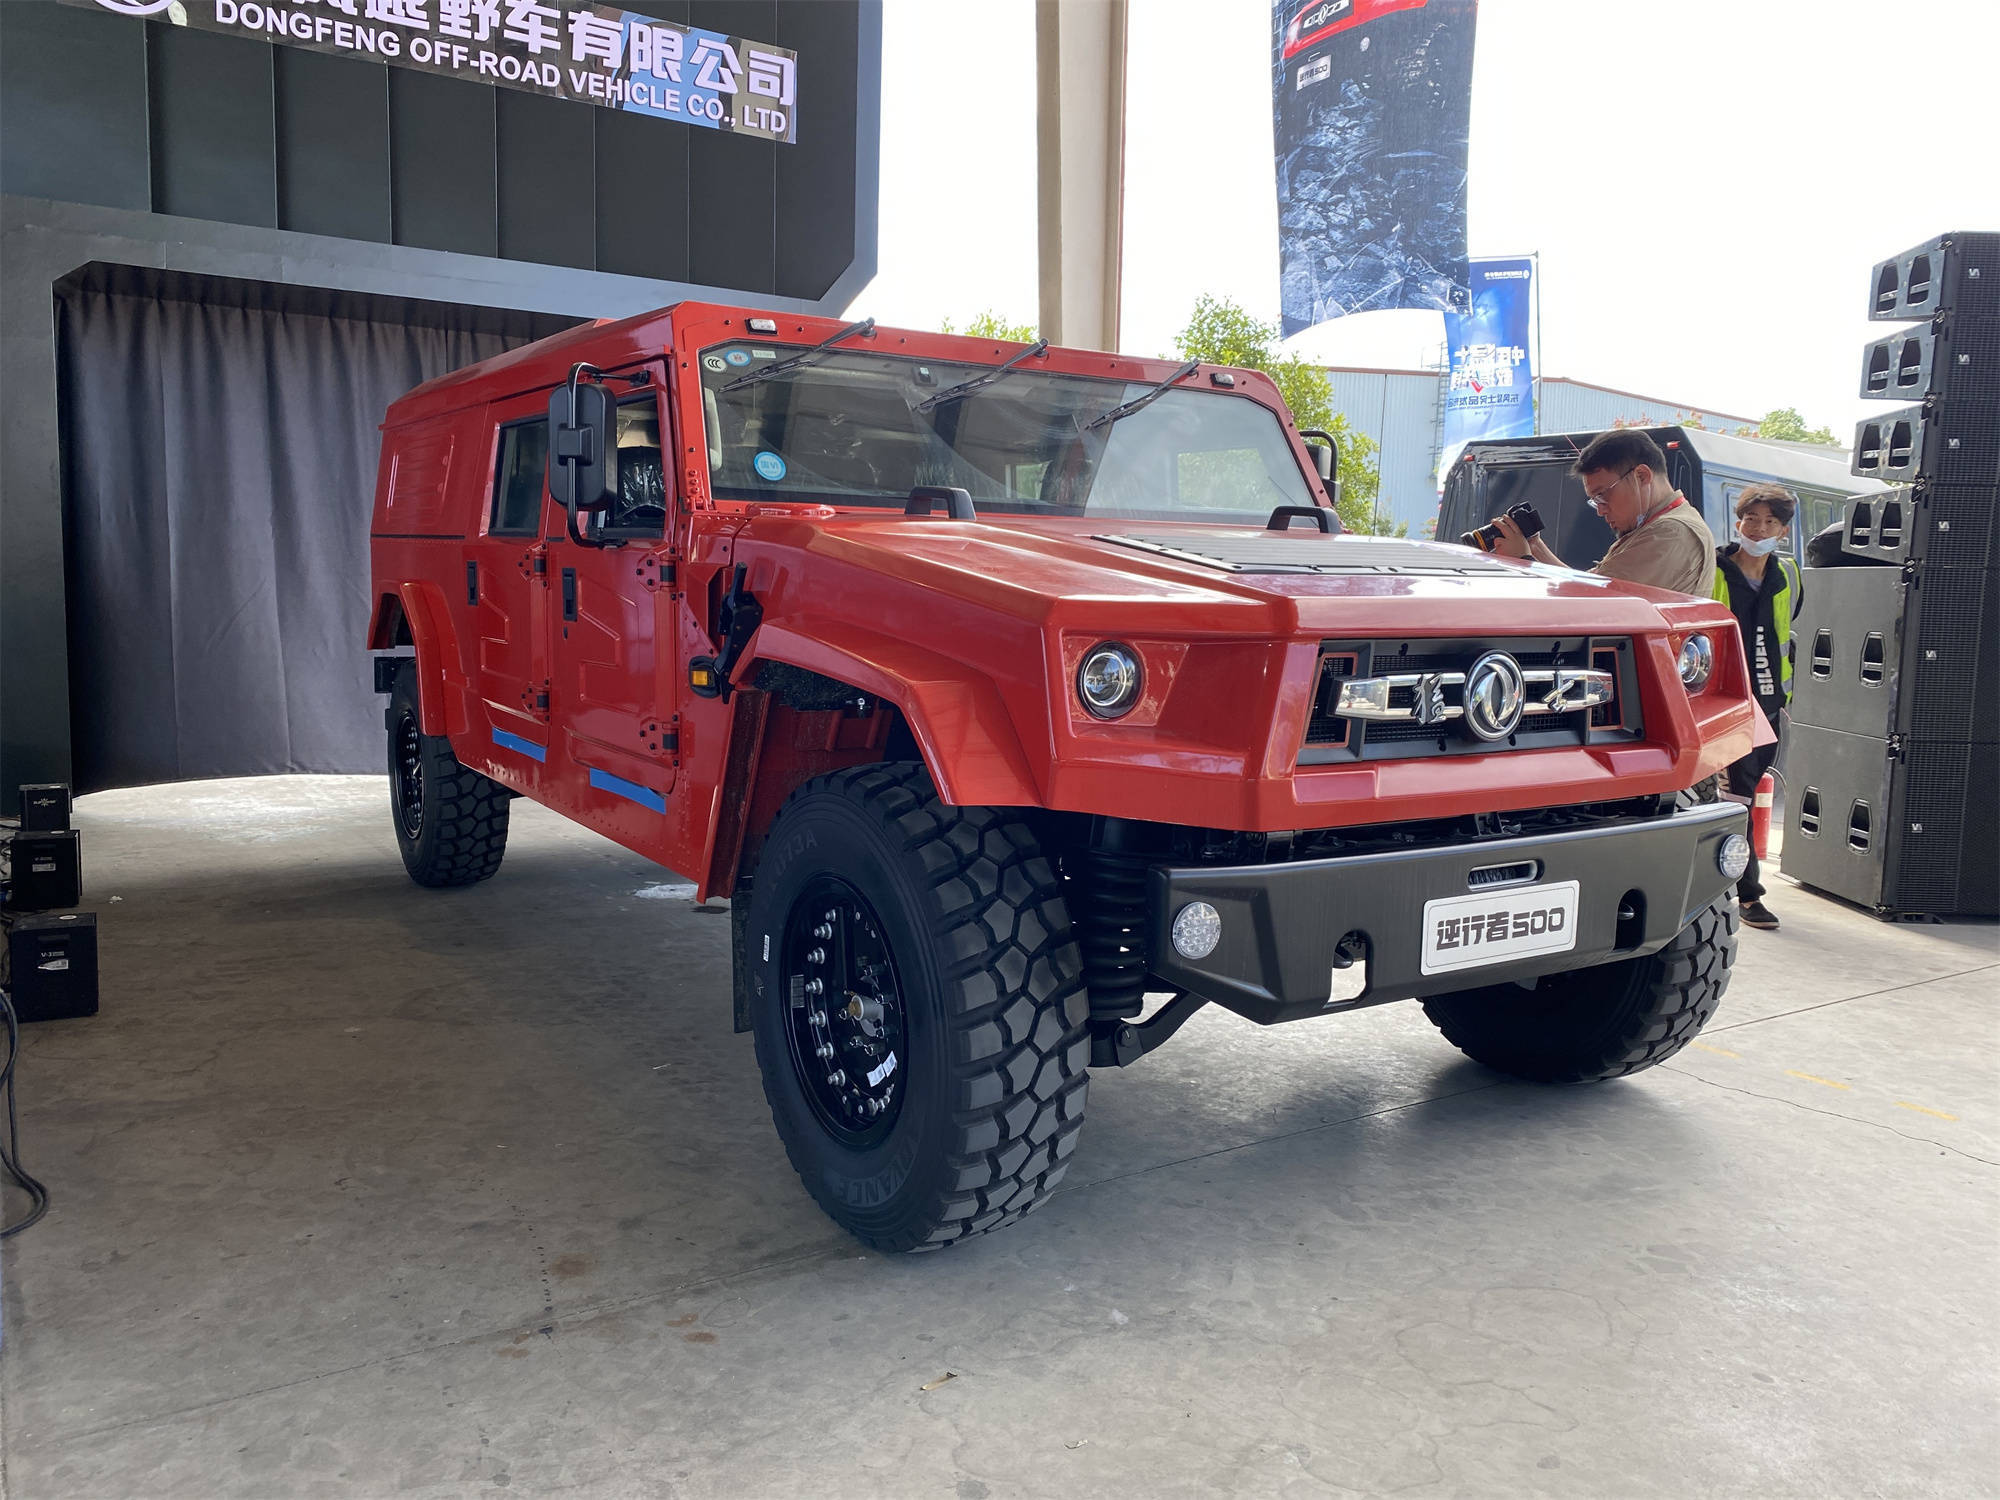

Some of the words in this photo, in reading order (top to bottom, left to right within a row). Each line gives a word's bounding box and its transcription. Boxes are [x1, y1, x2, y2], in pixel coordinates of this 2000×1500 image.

[215, 0, 401, 56] DONGFENG
[409, 38, 560, 88] OFF-ROAD
[568, 69, 680, 113] VEHICLE
[687, 93, 737, 126] CO.,
[742, 105, 786, 134] LTD
[1436, 906, 1566, 951] 逆行者500
